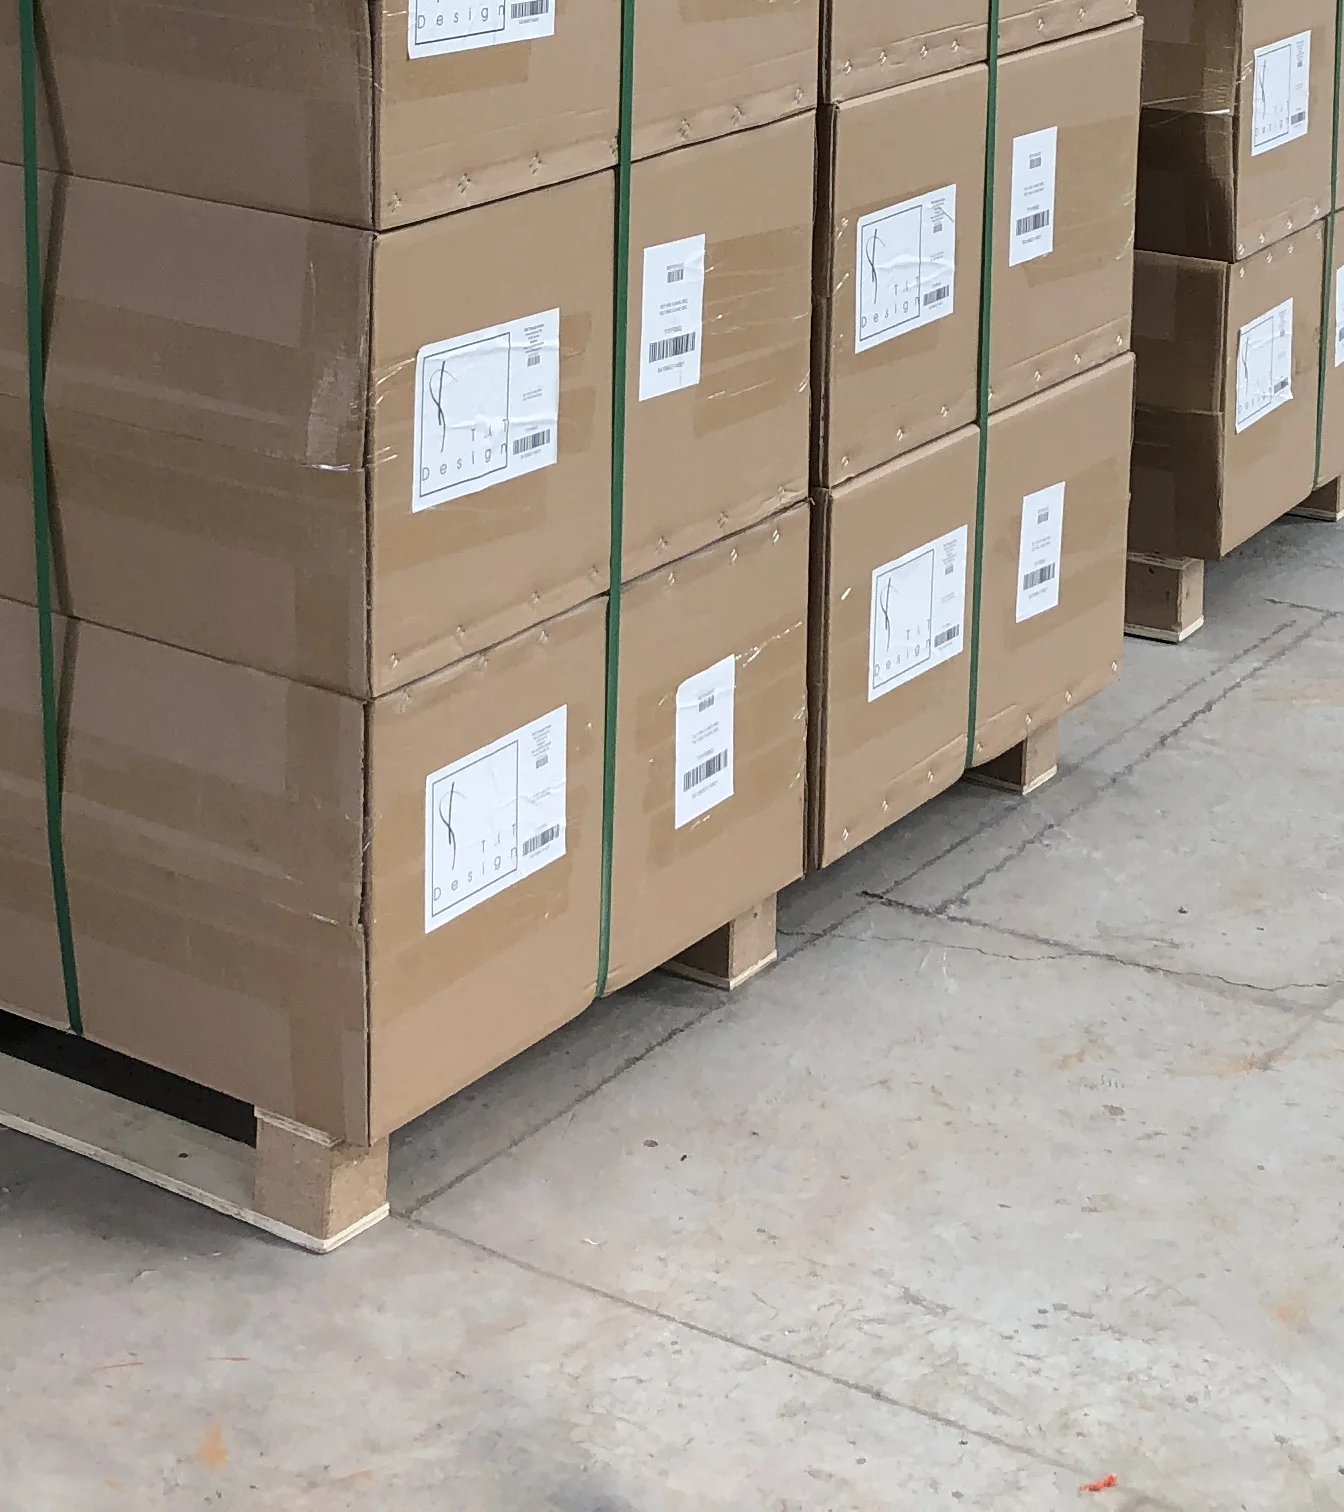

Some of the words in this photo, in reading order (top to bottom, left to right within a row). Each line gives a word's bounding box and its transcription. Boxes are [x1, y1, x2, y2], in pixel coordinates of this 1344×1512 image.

[418, 4, 505, 29] Design
[422, 442, 507, 481] Design
[434, 846, 518, 901] Design
